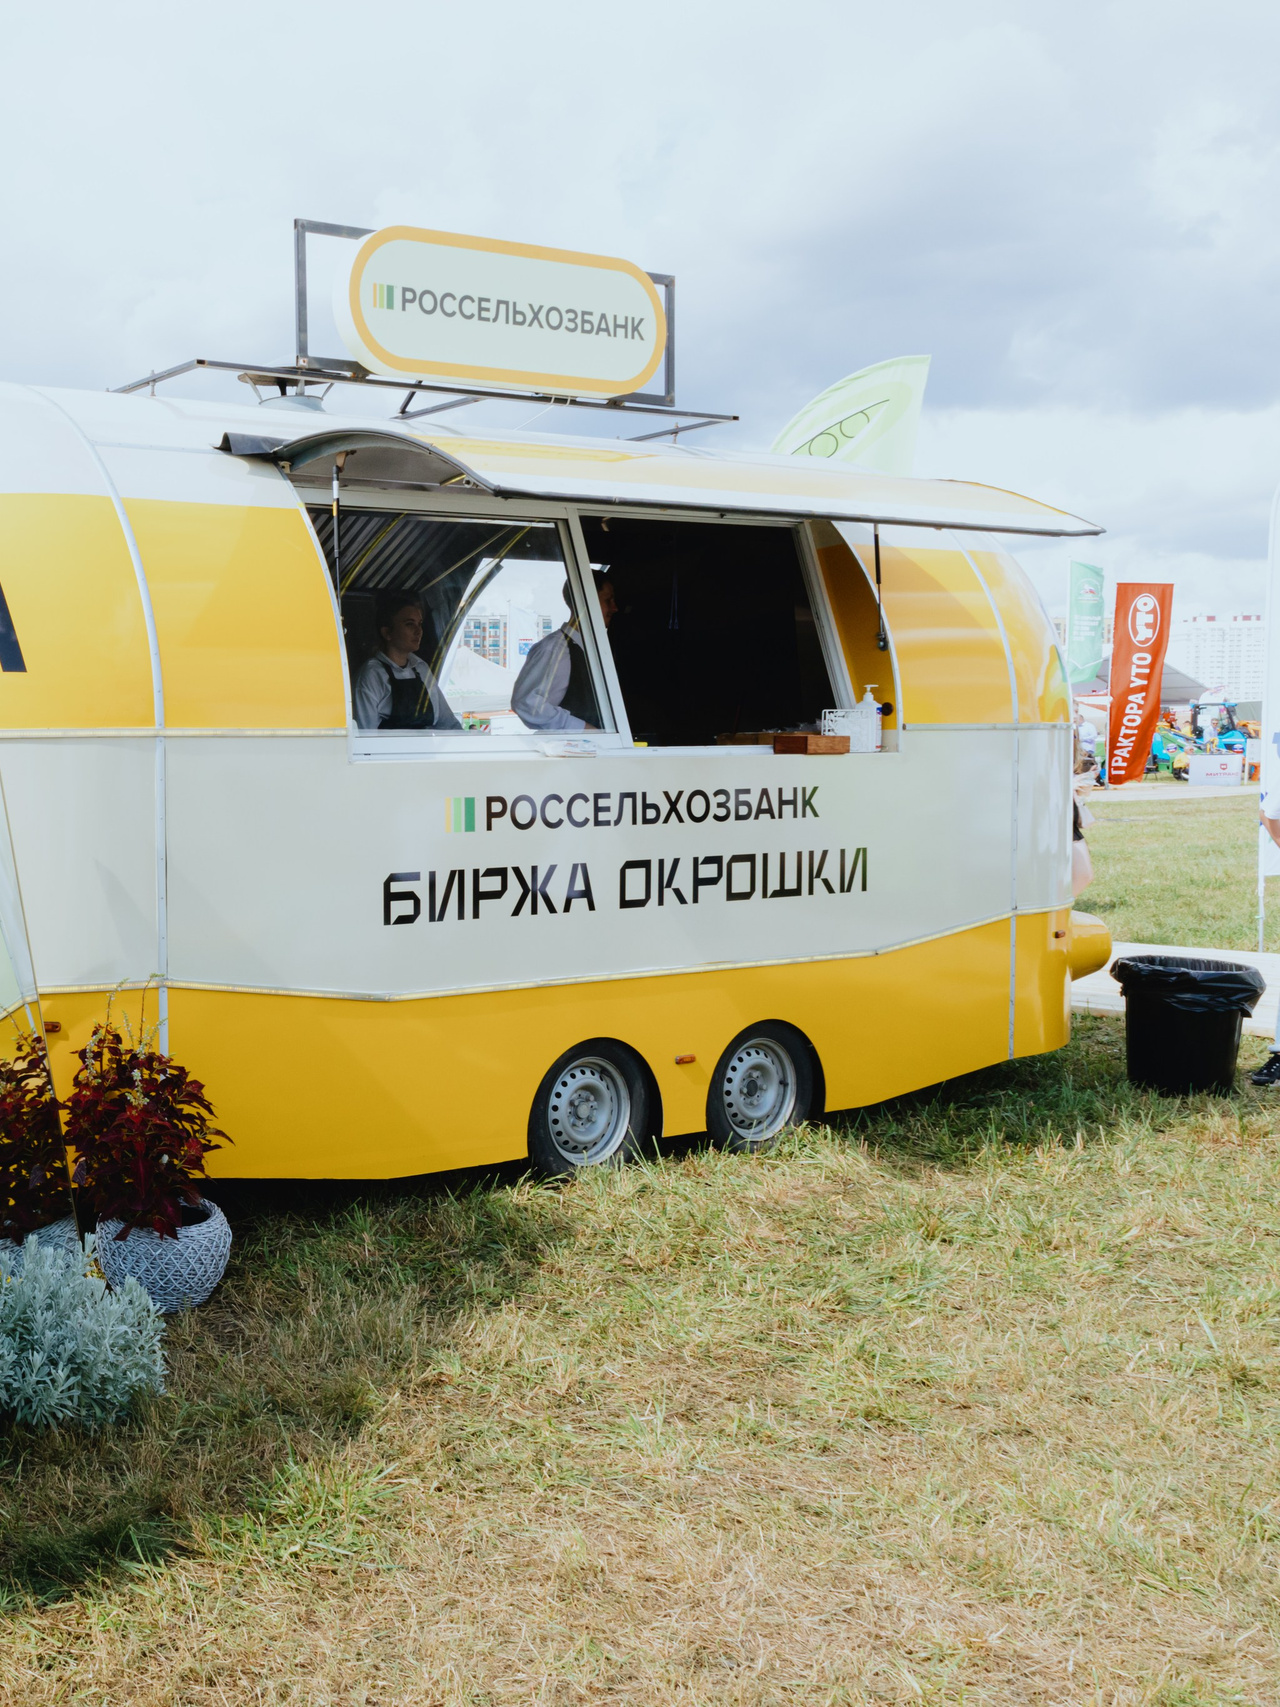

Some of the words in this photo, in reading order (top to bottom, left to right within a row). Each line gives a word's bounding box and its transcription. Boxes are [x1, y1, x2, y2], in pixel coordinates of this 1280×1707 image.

[401, 286, 645, 341] РОССЕЛЬХОЗБАНК
[486, 786, 820, 832] РОССЕЛЬХОЗБАНК
[383, 862, 596, 927] БИРЖА
[619, 847, 868, 910] ОКРОШКИ
